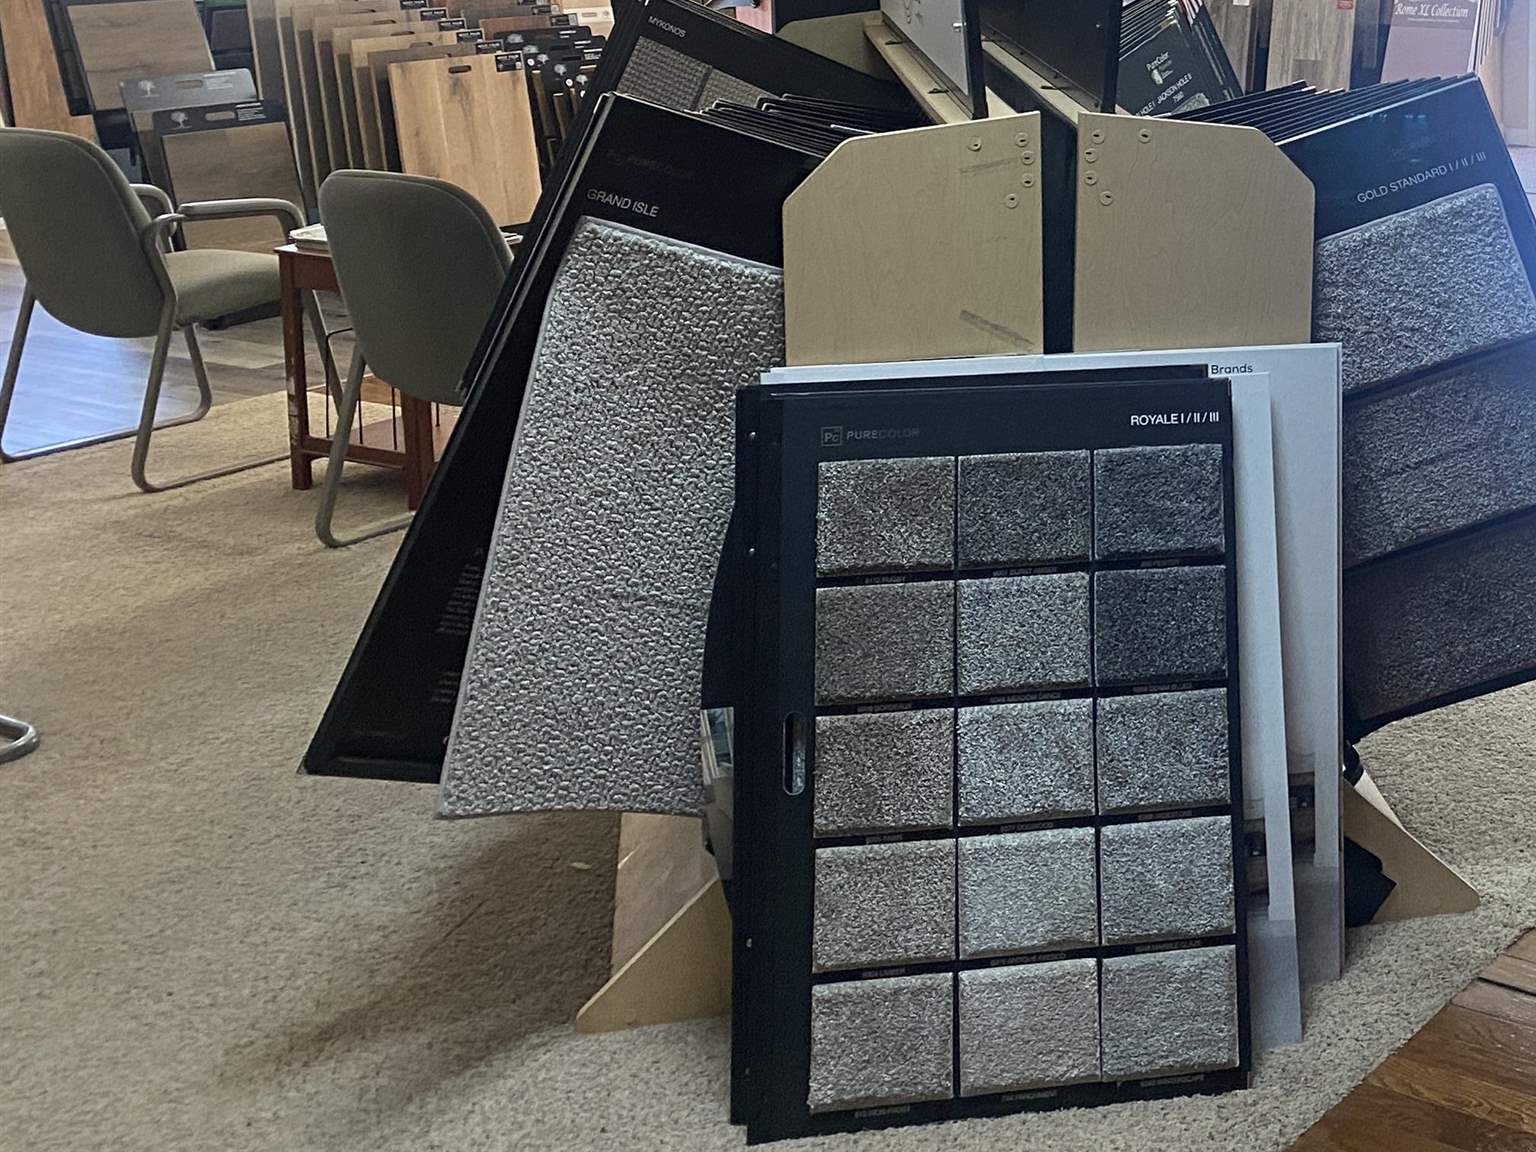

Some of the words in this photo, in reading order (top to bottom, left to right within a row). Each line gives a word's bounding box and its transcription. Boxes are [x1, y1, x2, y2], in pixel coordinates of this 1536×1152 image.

[1394, 3, 1418, 16] Rome
[1431, 3, 1469, 17] Collection
[648, 16, 687, 37] MYKONOS
[1356, 185, 1388, 203] GOLD
[1389, 165, 1448, 193] STANDARD
[586, 189, 632, 209] GRAND
[632, 200, 660, 218] ISLE
[1211, 363, 1254, 375] Brands
[1130, 412, 1179, 426] ROYALE
[846, 429, 920, 440] PURECOLOR
